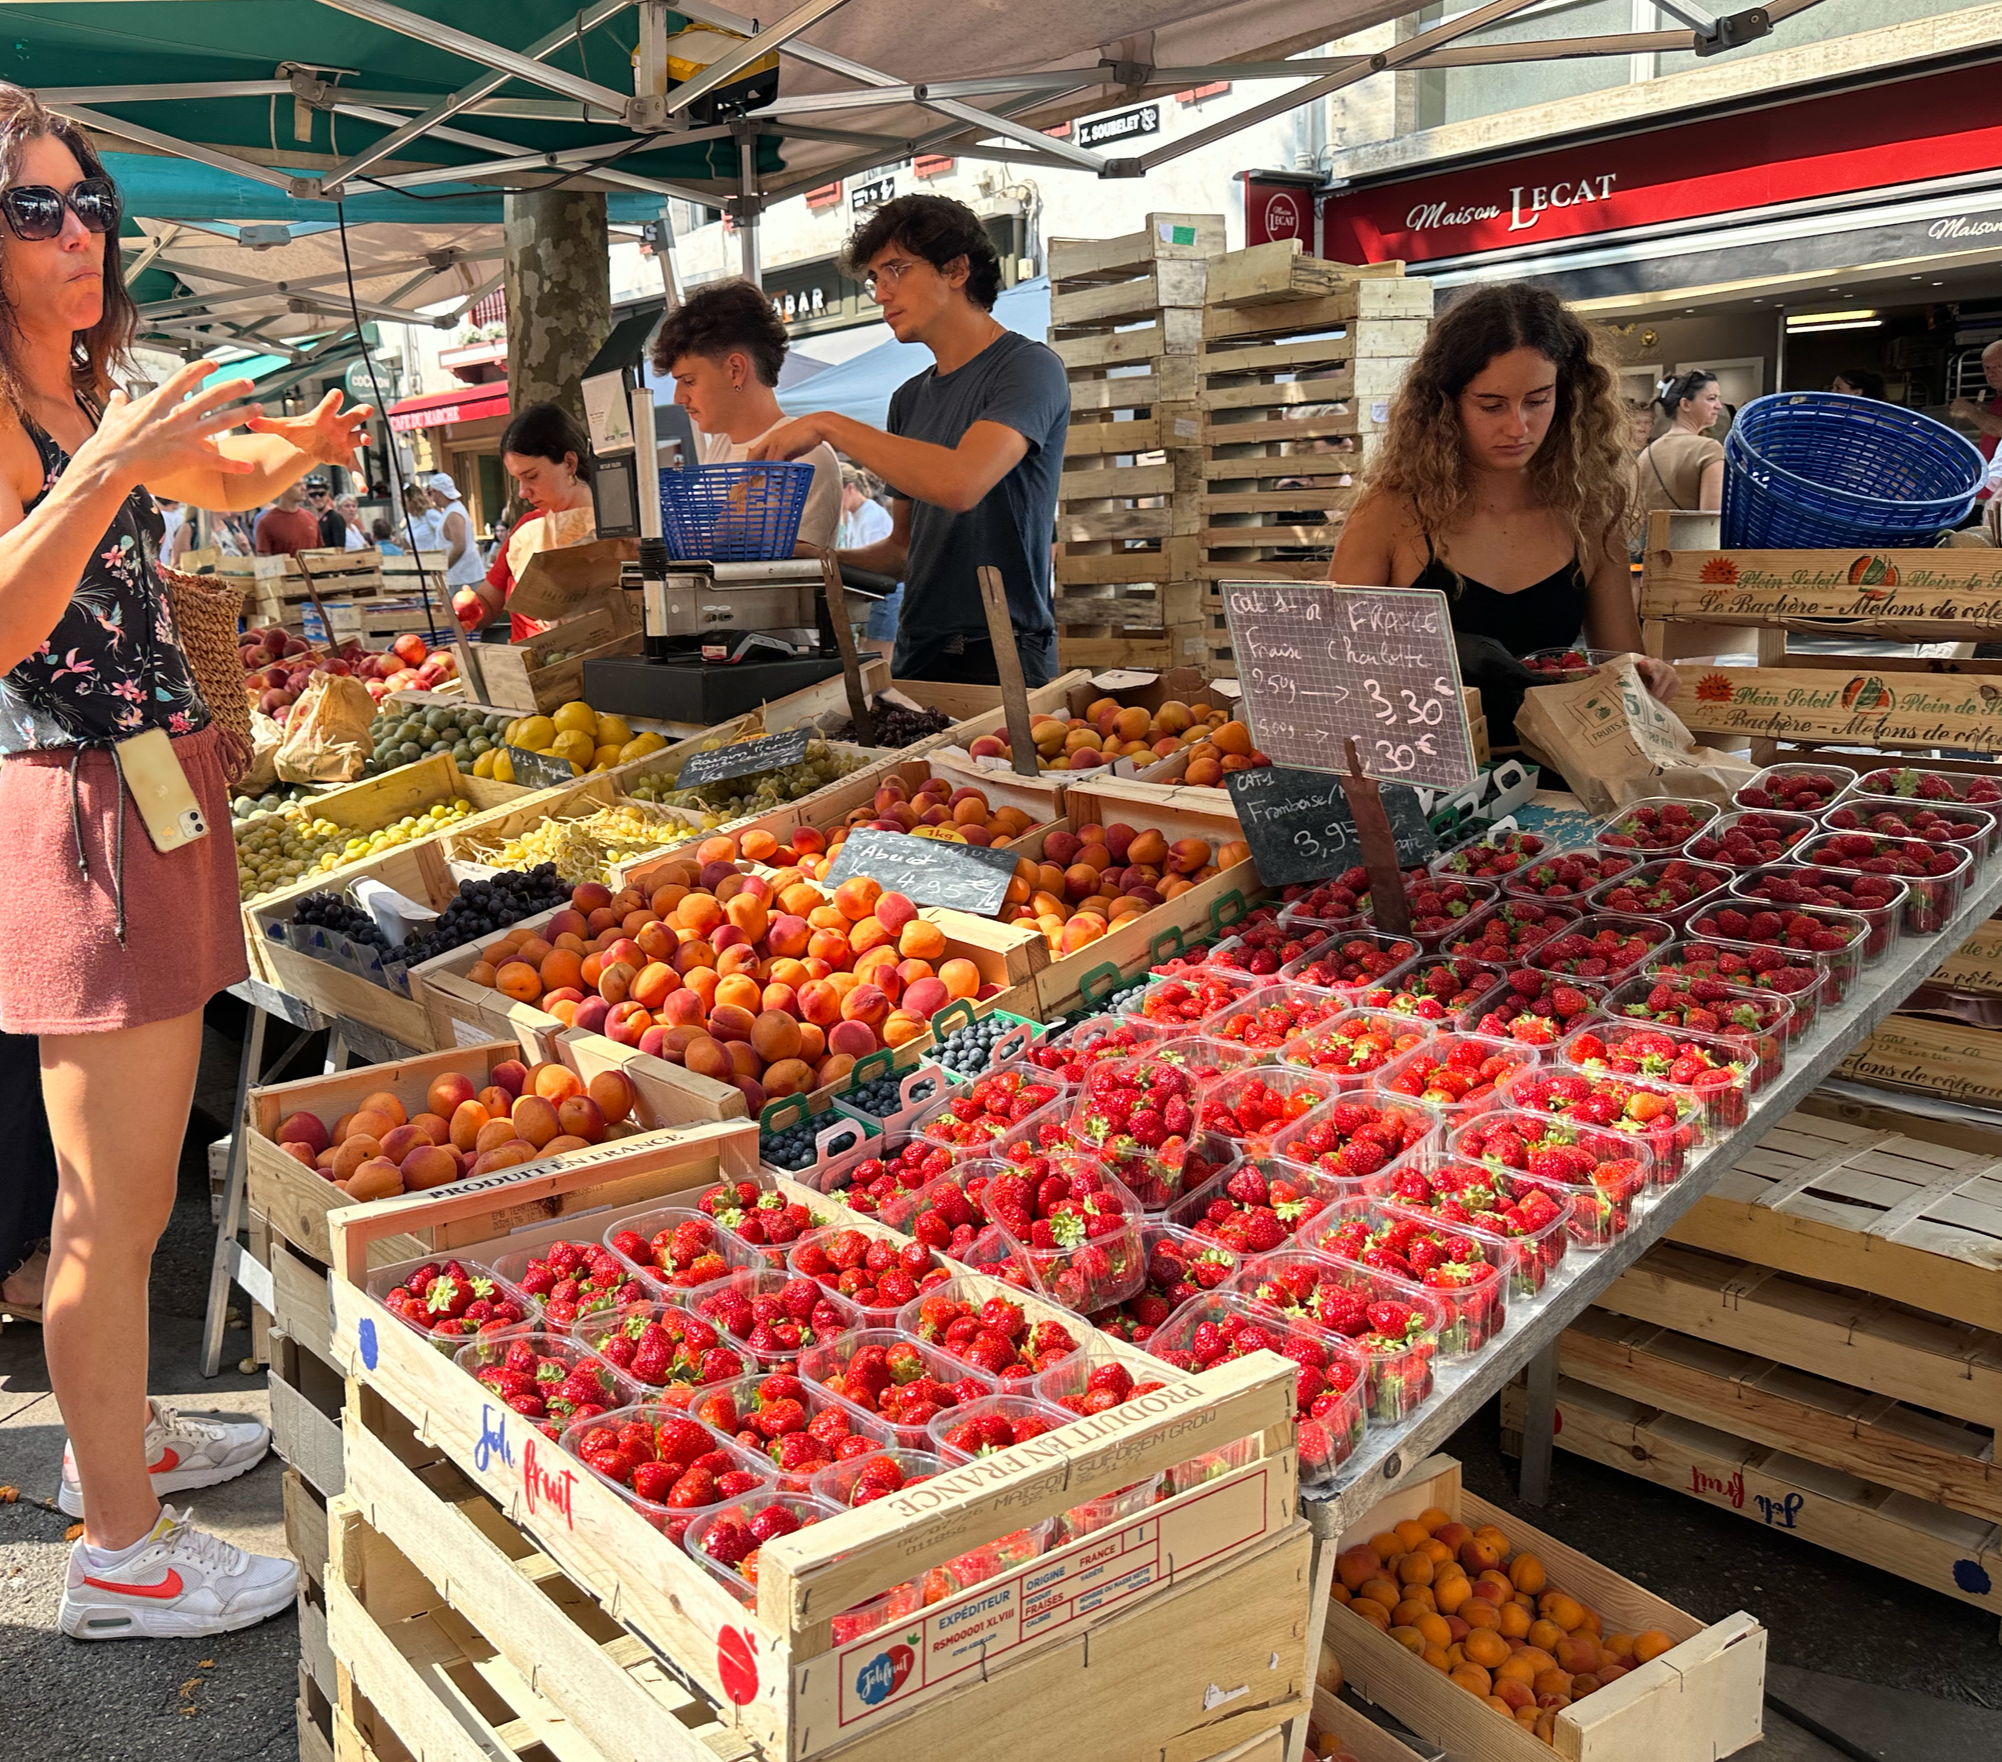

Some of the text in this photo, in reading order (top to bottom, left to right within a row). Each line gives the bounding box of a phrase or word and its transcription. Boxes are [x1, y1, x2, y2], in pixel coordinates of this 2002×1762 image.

[1405, 173, 1616, 232] Maison LECAT
[1730, 594, 1818, 616] Bachère
[1246, 626, 1302, 660] Fraise
[1252, 668, 1296, 704] 250g
[1733, 686, 1841, 710] Plein Soleil
[1900, 693, 1951, 713] Plein
[1954, 698, 1977, 715] de
[1592, 724, 1622, 742] FRUITS
[1727, 709, 1812, 734] Bachère
[1922, 723, 1950, 741] de
[927, 830, 954, 841] 1kg
[1900, 1066, 1928, 1084] de
[428, 1167, 550, 1199] PRODUIT
[590, 1133, 685, 1162] FRANCE
[889, 1383, 1206, 1518] PRODUIT EN FRANCE
[524, 1418, 580, 1532] fruit
[1686, 1465, 1745, 1509] fruit
[938, 1590, 1011, 1630] EXPÉDITEUR
[1026, 1566, 1066, 1591] ORIGINE
[1079, 1544, 1116, 1567] FRANCE
[1025, 1592, 1064, 1617] FRAISES
